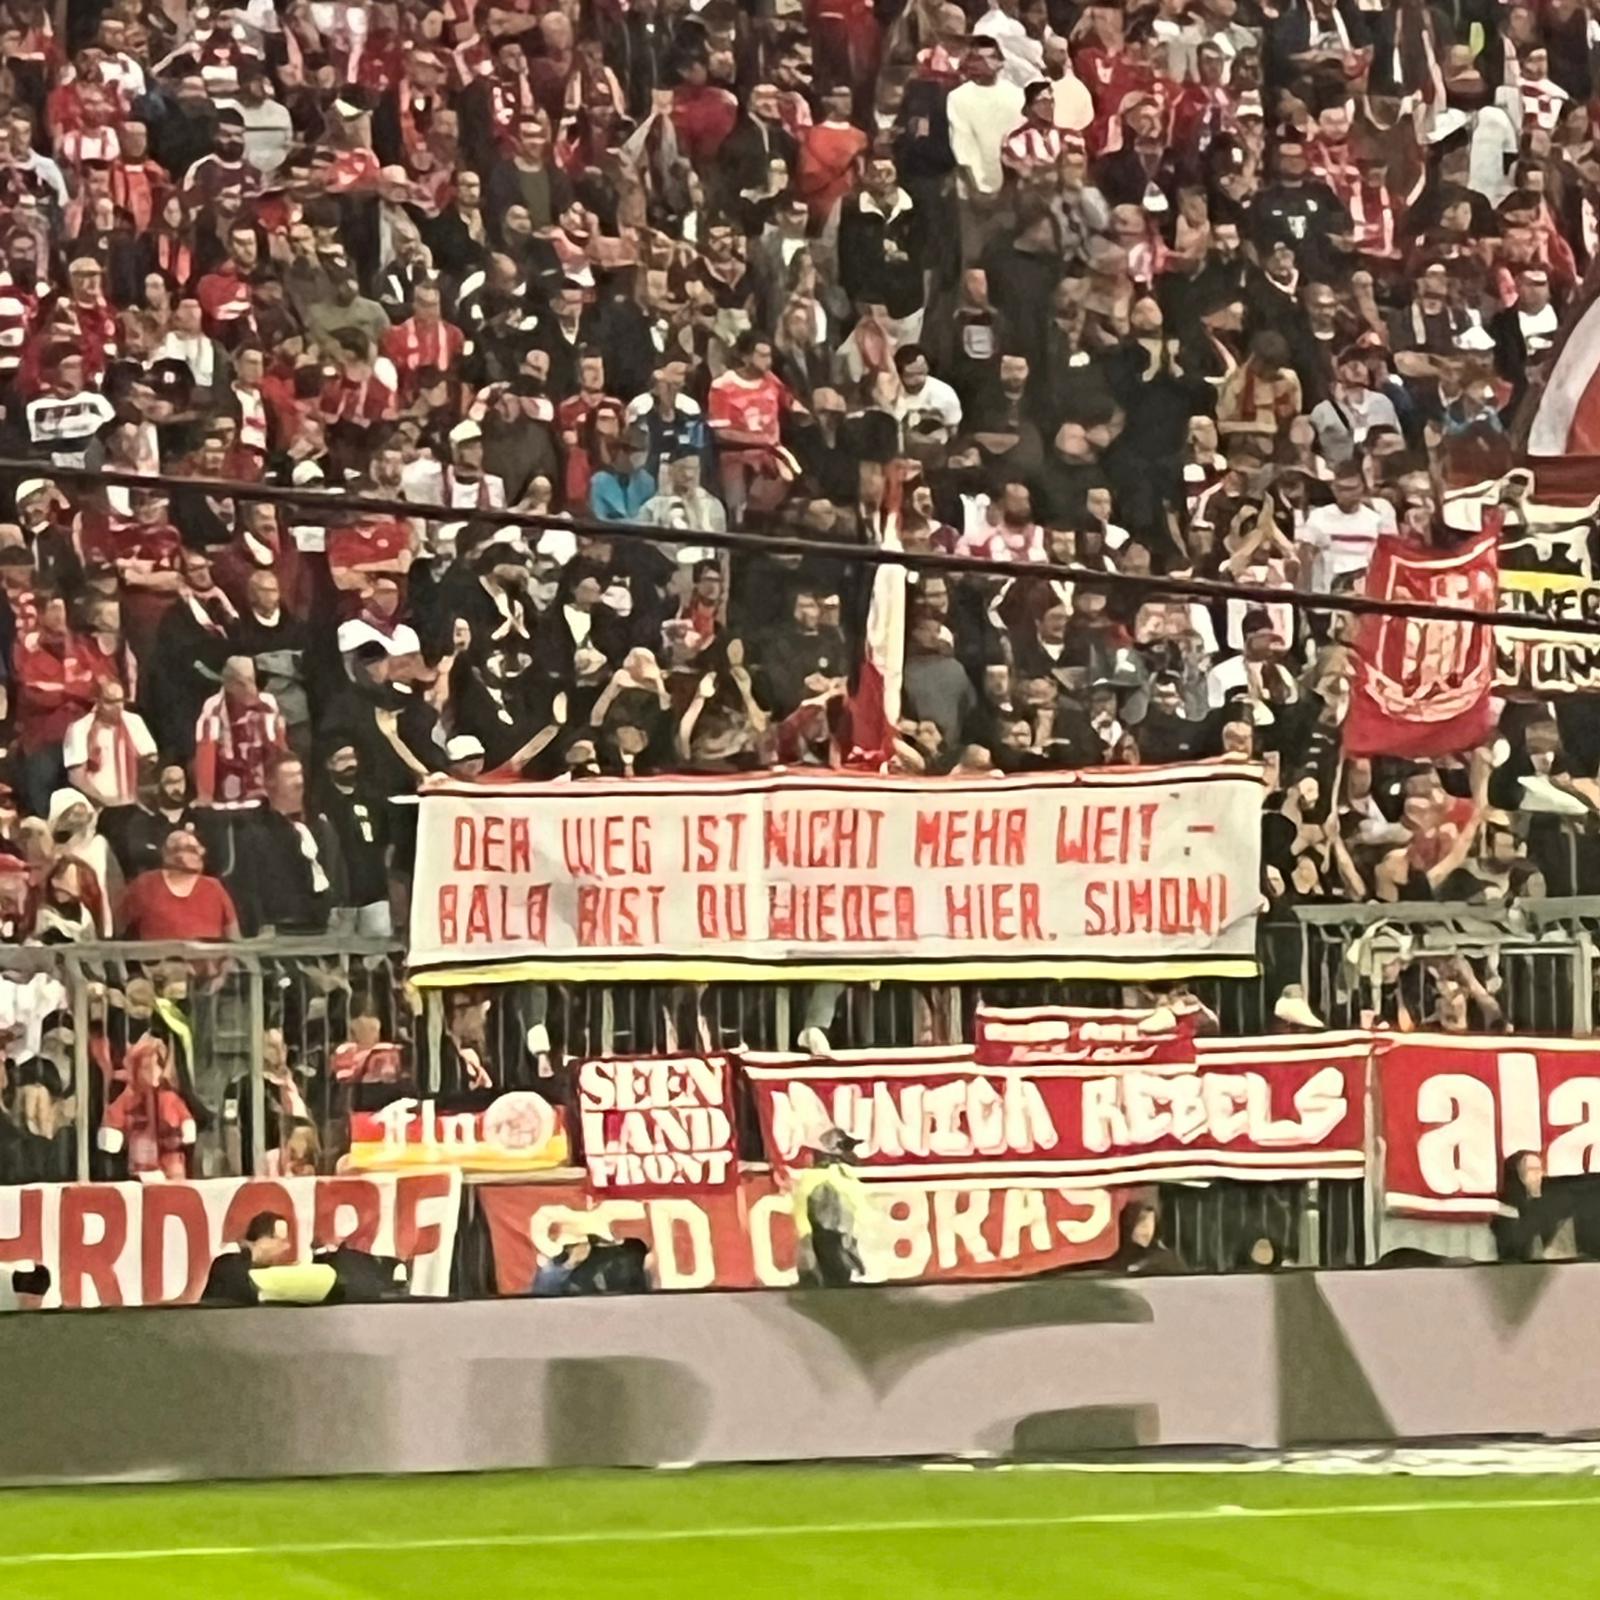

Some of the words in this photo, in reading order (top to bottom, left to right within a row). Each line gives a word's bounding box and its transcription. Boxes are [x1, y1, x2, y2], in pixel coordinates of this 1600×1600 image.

[453, 815, 531, 873] DER
[562, 815, 652, 880] WEG
[683, 813, 747, 872] IST
[763, 808, 886, 868] NICHT
[914, 806, 1027, 868] MEHR
[438, 883, 552, 946] BALD
[577, 884, 665, 947] BIST
[696, 883, 748, 940] DU
[579, 1057, 727, 1111] SEEN
[1082, 1066, 1347, 1153] REBELS
[581, 1106, 731, 1155] LAND
[586, 1150, 733, 1187] FRONT
[749, 1187, 1111, 1287] CBRAS
